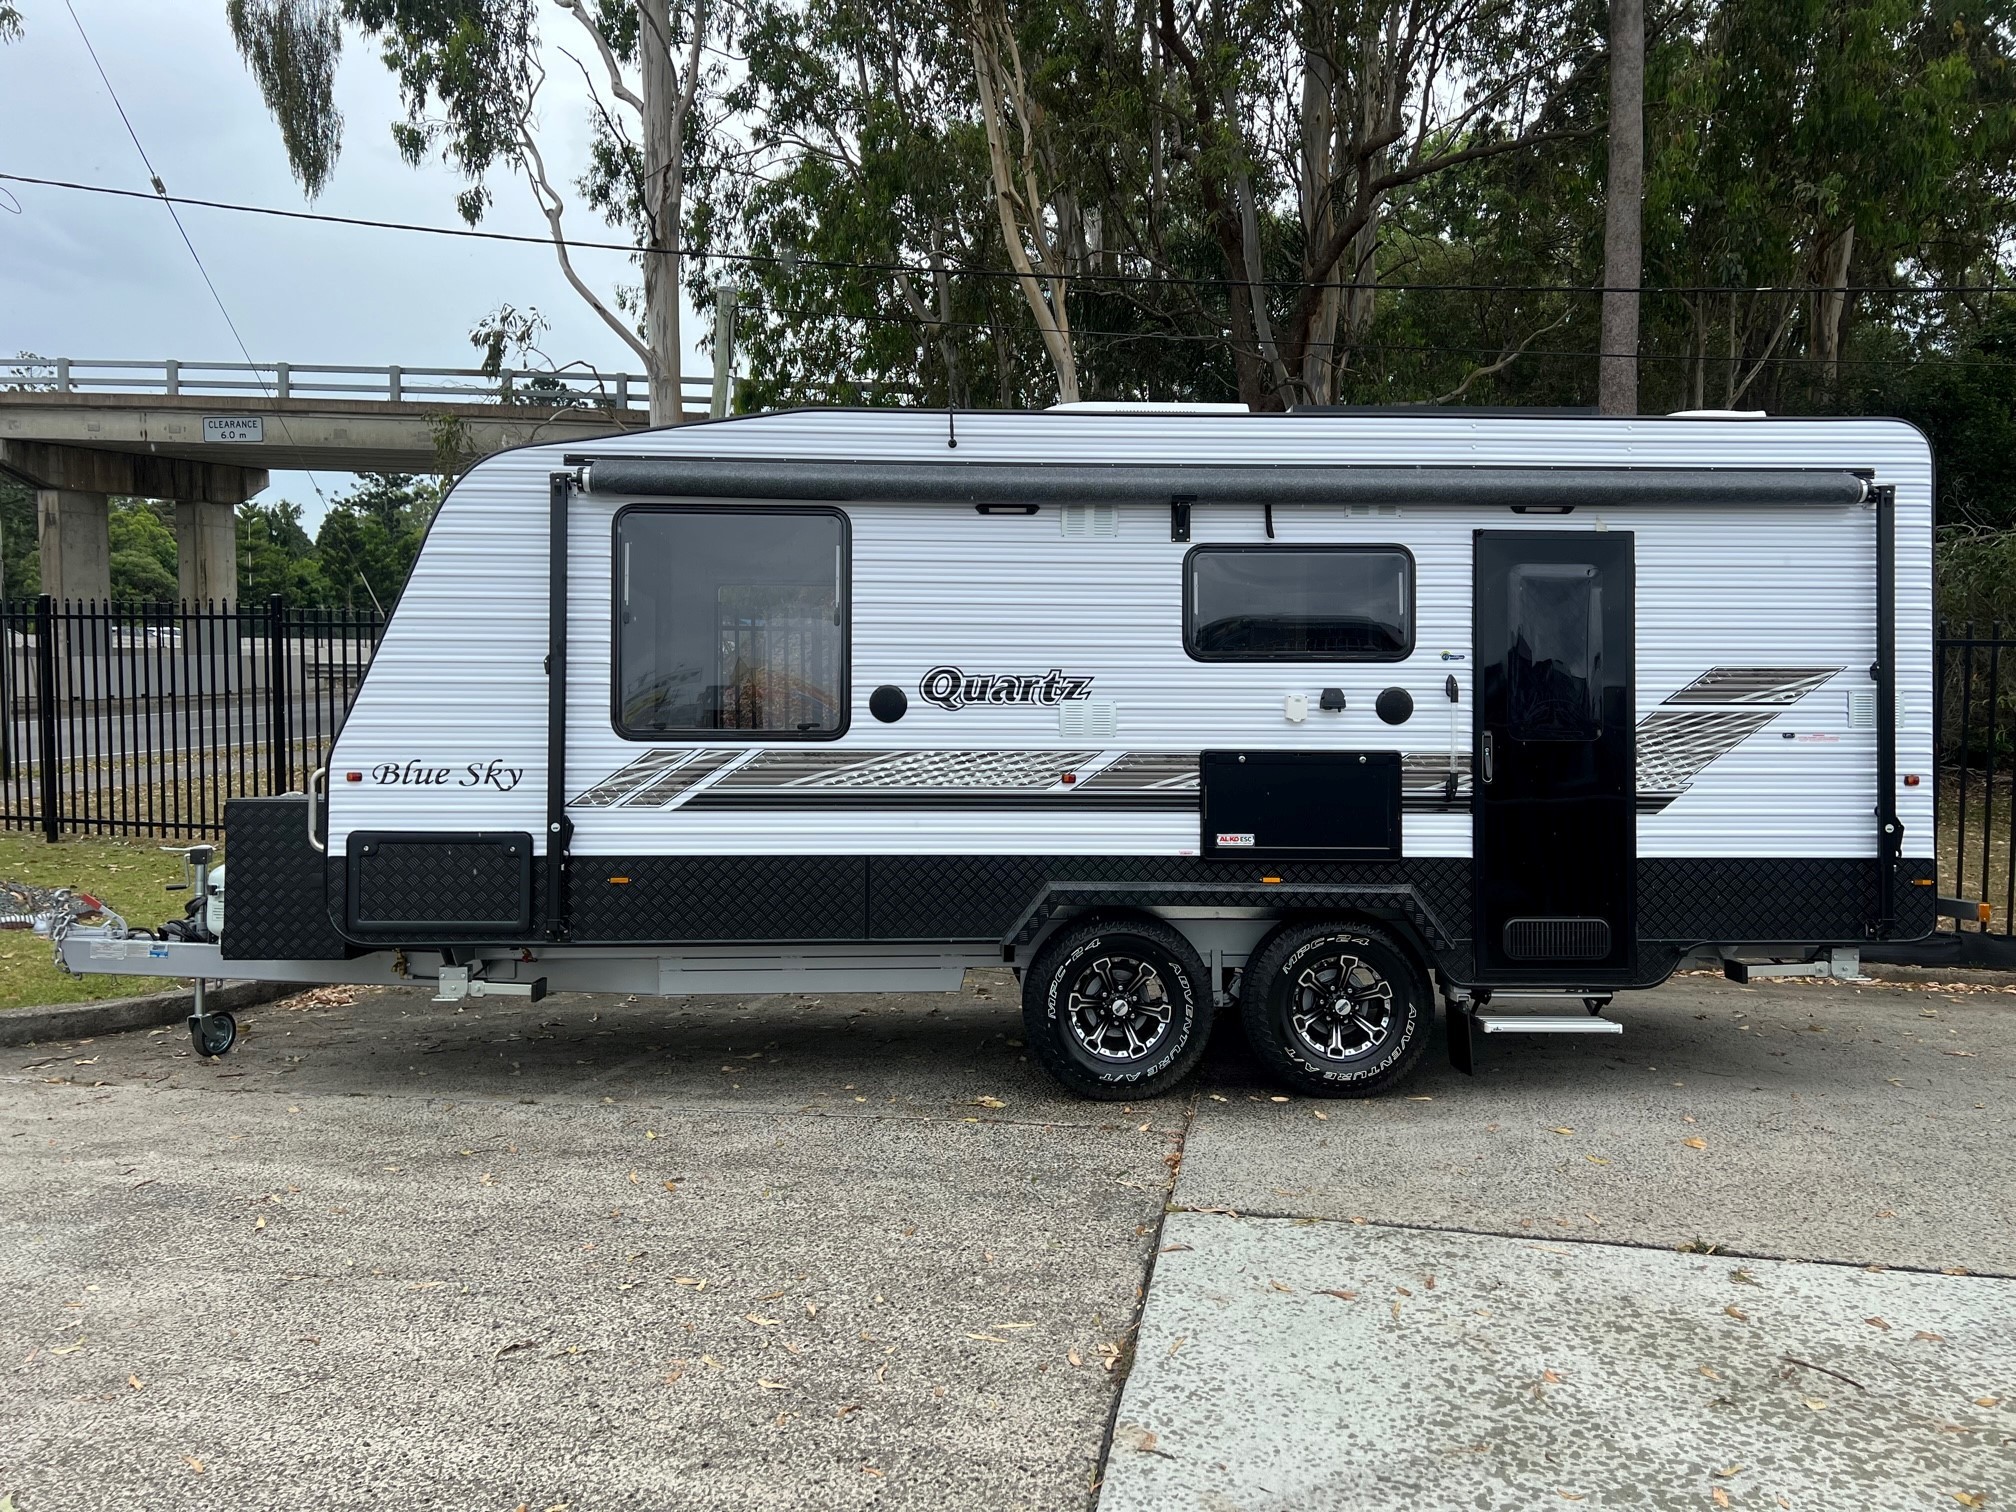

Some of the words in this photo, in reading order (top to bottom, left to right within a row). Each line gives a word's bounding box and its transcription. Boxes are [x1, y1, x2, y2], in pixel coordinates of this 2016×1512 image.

[208, 420, 258, 428] CLEARANCE
[221, 431, 235, 439] 6.0
[919, 665, 1095, 711] Quartz
[372, 759, 450, 785] Blue
[458, 759, 523, 791] Sky
[1147, 962, 1194, 1077] ADVENTURE
[1323, 1002, 1417, 1081] ADVENTURE
[1284, 1046, 1320, 1073] A/T
[1099, 1071, 1142, 1082] A/T
